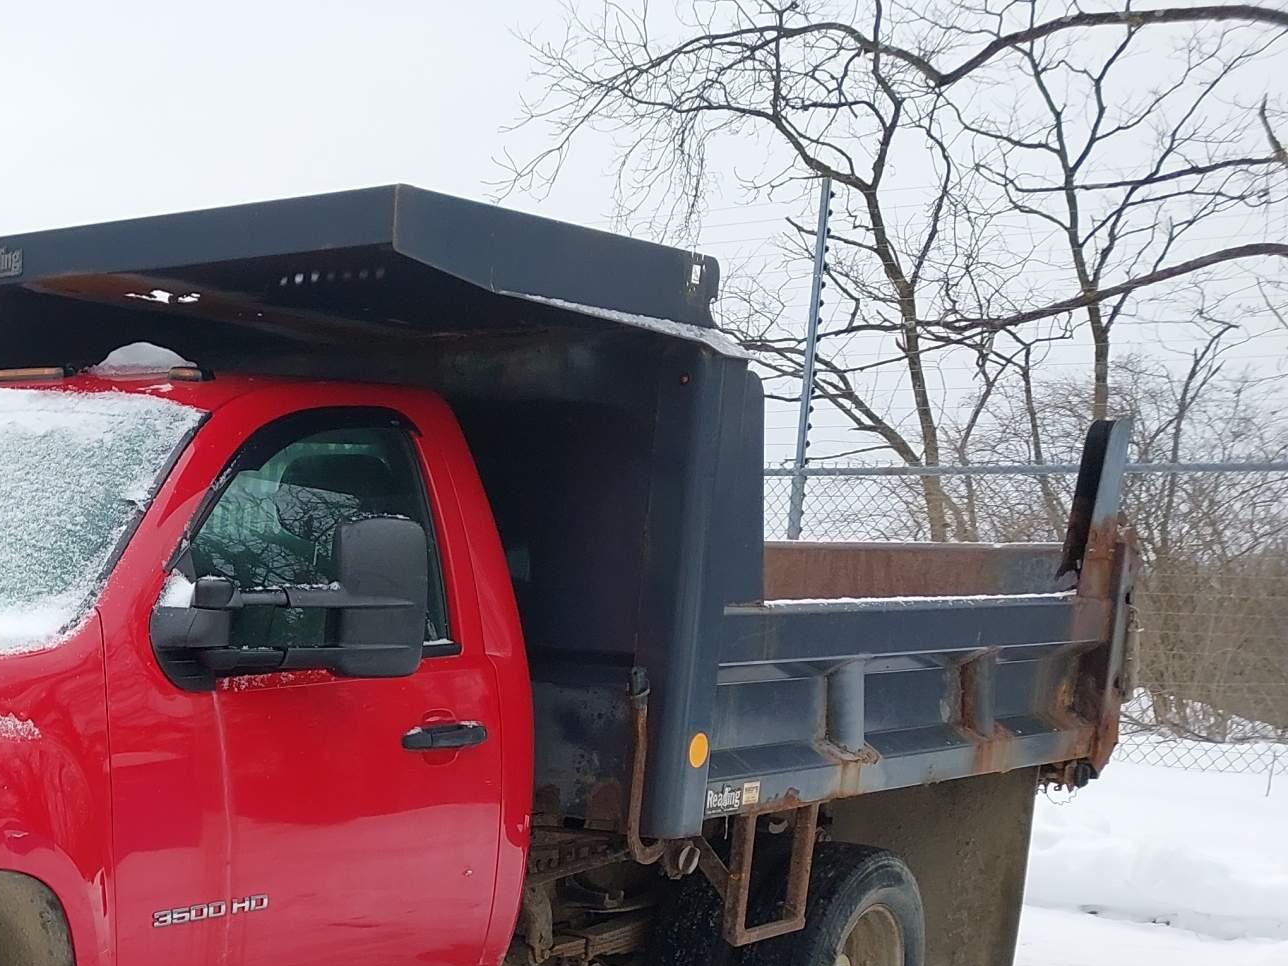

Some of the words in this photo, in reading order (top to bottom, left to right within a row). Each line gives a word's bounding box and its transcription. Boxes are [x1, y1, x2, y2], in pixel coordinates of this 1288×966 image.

[707, 787, 741, 808] Reading
[153, 901, 226, 928] 3500
[232, 895, 268, 914] HD
